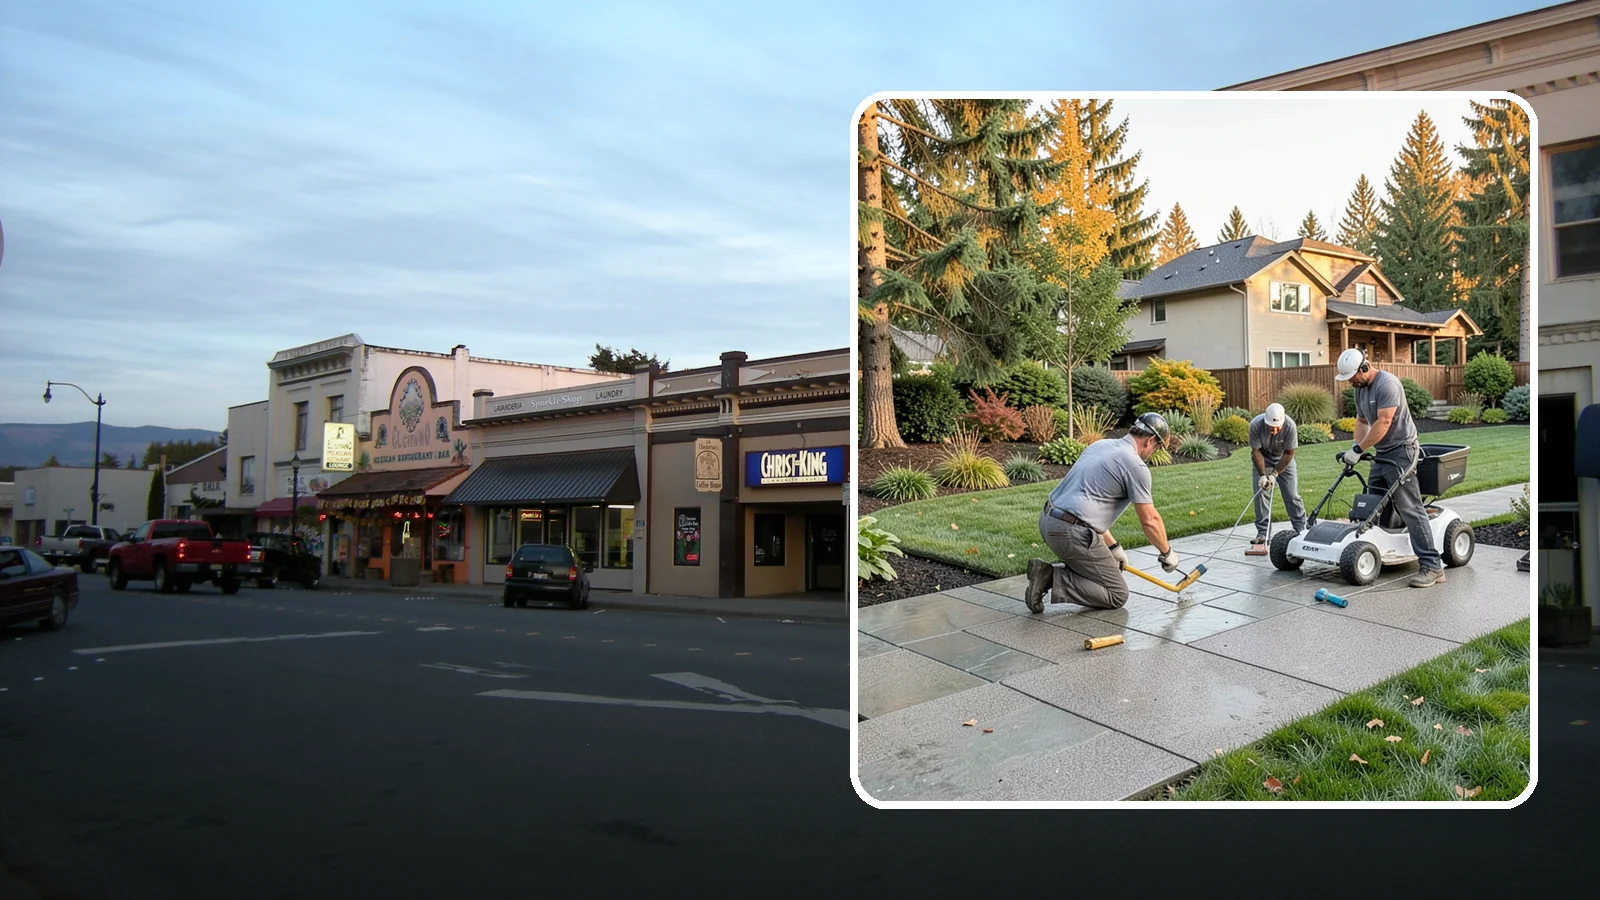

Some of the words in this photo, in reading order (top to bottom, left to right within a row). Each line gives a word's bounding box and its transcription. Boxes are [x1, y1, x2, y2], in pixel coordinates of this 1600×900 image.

[531, 394, 560, 409] Sparkle
[561, 394, 582, 405] Shop
[595, 389, 623, 400] LAUNDRY
[493, 402, 523, 413] LAVANDERIA
[373, 454, 396, 464] MEXICAN
[397, 451, 433, 462] RESTAURANT
[437, 450, 450, 459] BAR
[760, 452, 798, 478] CHRIST
[799, 450, 827, 476] KING
